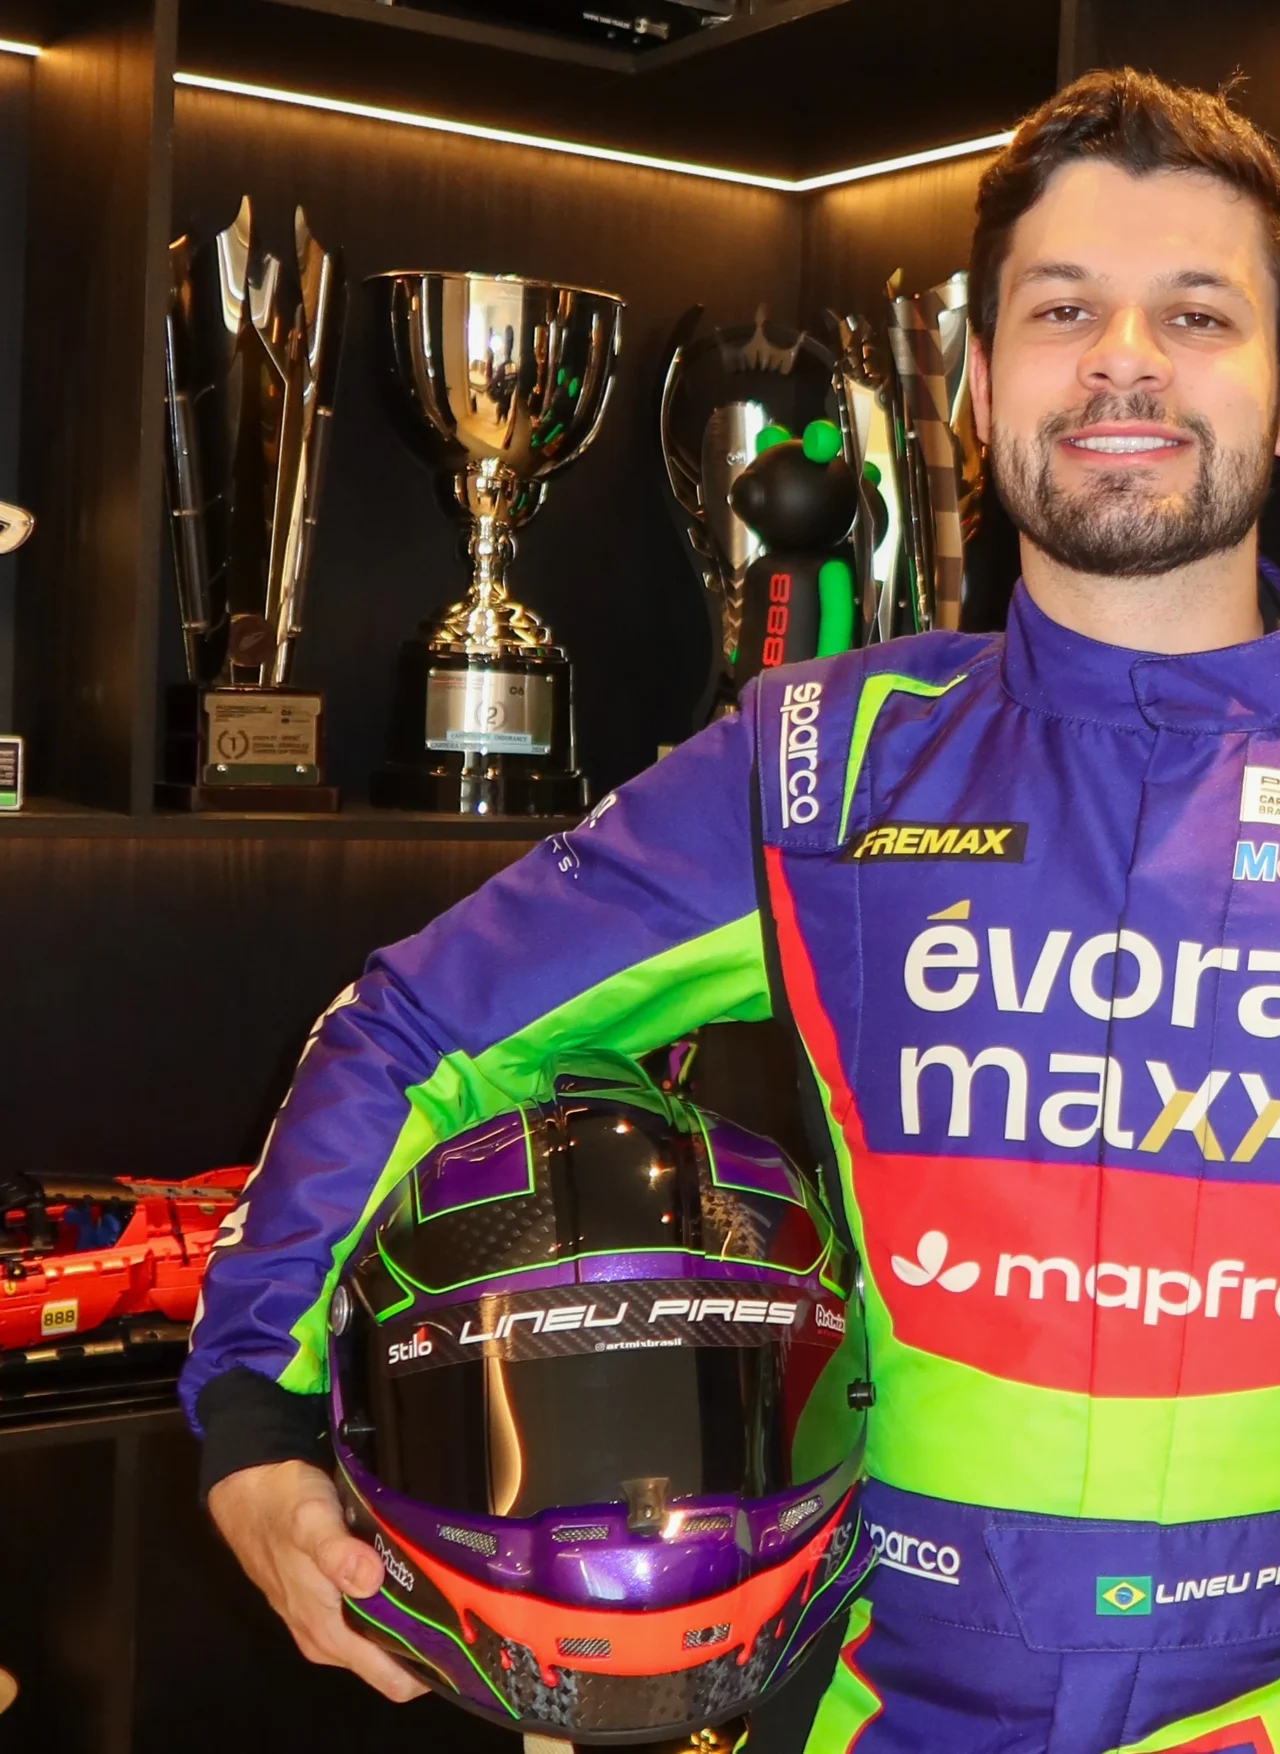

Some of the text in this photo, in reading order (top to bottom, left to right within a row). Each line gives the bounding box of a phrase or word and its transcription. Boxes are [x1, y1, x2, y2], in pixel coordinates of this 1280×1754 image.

[780, 683, 822, 824] sparco
[853, 827, 1012, 858] FREMAX
[43, 1310, 75, 1327] 888
[459, 1299, 797, 1345] LINEU PIRES
[388, 1332, 433, 1364] Stilo
[865, 1520, 960, 1577] parco
[1155, 1572, 1249, 1606] LINEU
